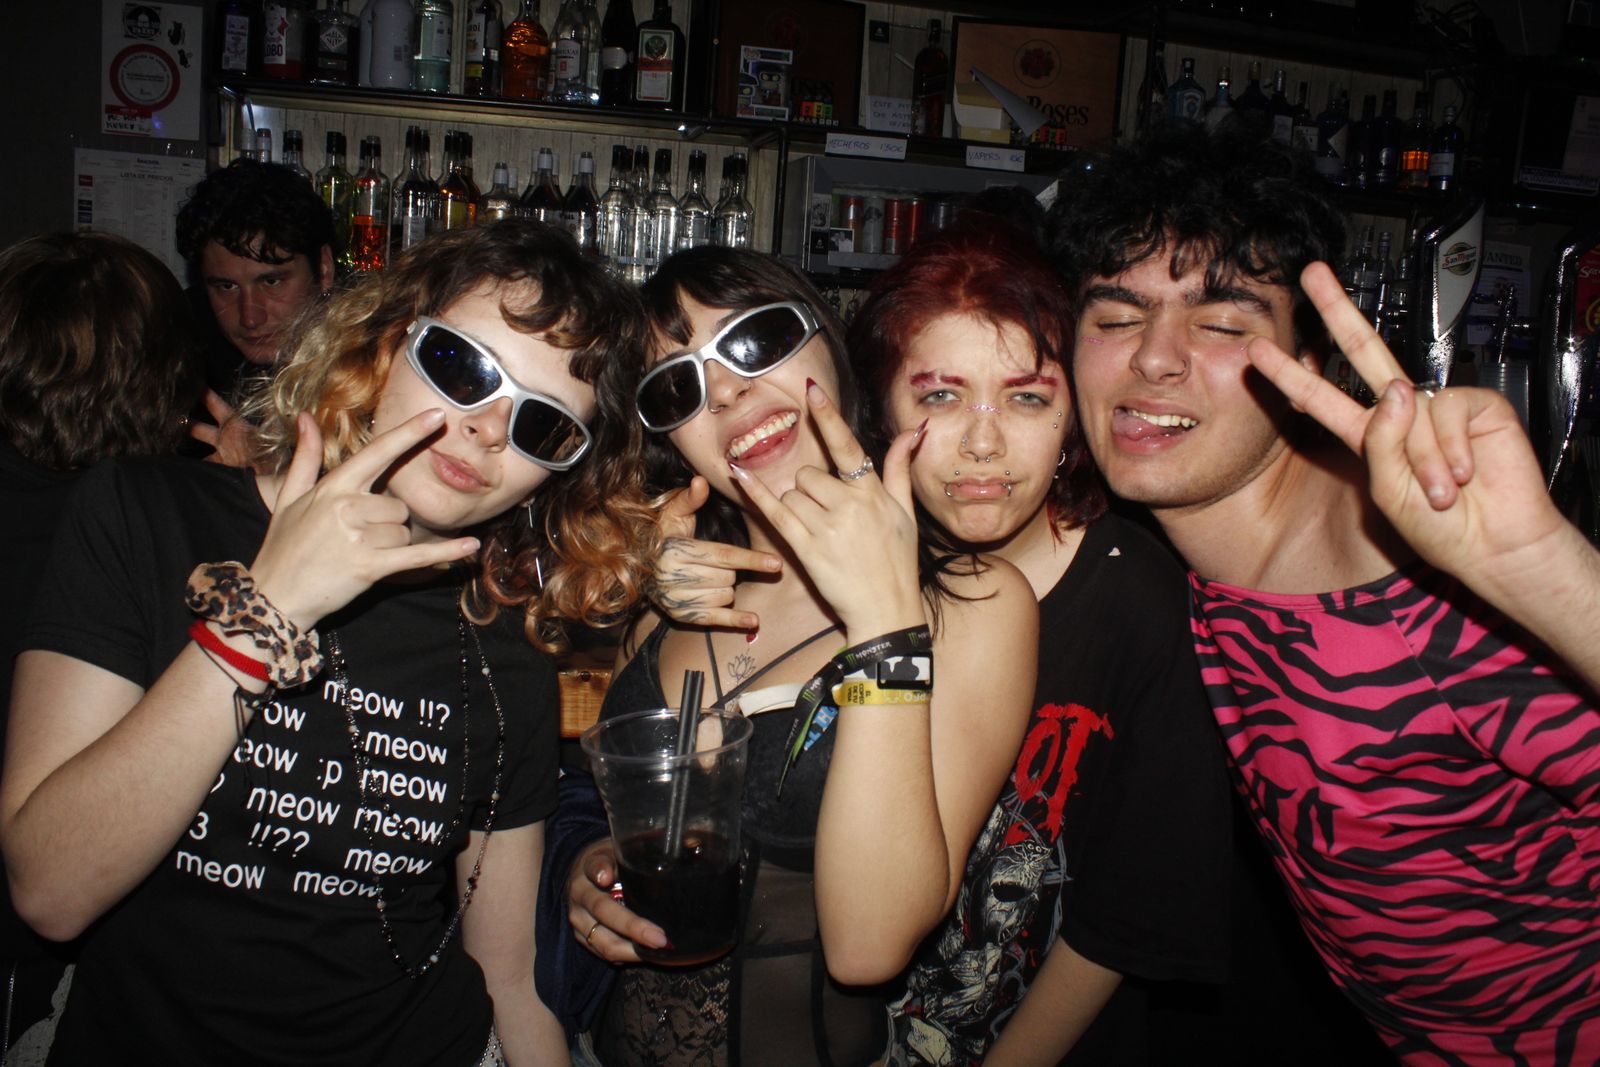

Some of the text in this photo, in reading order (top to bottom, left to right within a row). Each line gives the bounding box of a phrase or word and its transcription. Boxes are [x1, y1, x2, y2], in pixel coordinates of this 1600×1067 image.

[855, 641, 892, 659] MONSTER
[263, 702, 448, 766] ow meow
[324, 679, 451, 732] meow !!?
[233, 738, 448, 804] eow :p meow
[1015, 702, 1115, 845] OT
[246, 786, 445, 847] meow meow
[176, 849, 384, 898] meow meow
[247, 821, 311, 859] !!??
[343, 847, 433, 876] meow
